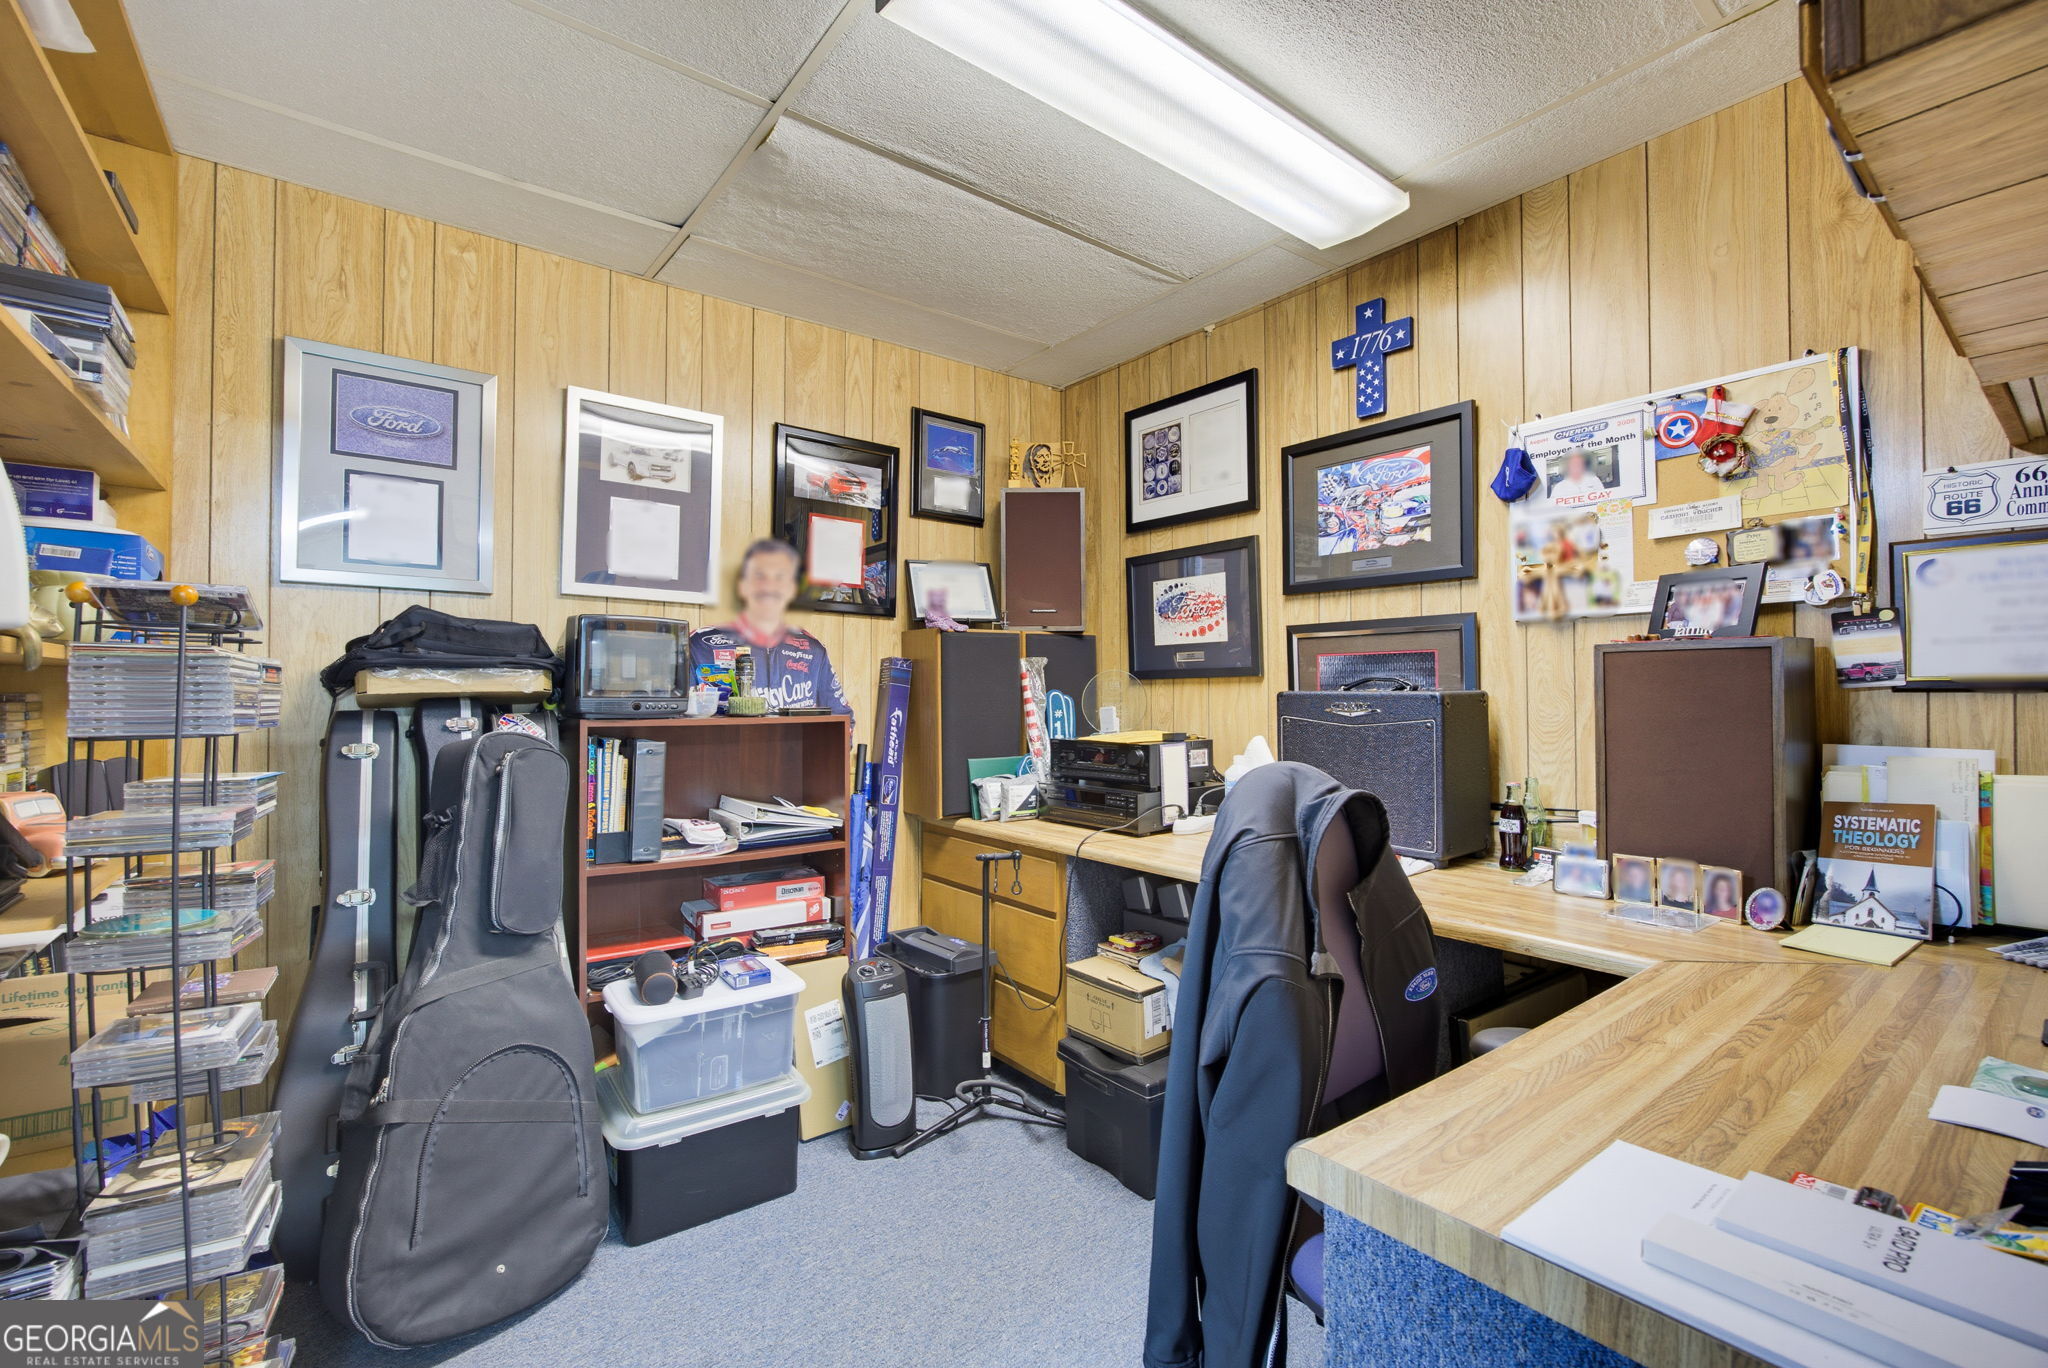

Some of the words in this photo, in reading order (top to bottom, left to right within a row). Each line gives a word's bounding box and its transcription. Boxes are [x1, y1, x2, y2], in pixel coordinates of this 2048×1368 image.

[1350, 326, 1393, 360] 1776
[368, 408, 423, 433] Ford
[1554, 422, 1608, 440] CHEROKEE
[1588, 437, 1602, 448] the
[1606, 433, 1636, 444] Month
[1374, 462, 1410, 482] Ford
[1944, 480, 1984, 489] HISTORIC
[1556, 495, 1584, 505] PETE
[1588, 491, 1611, 501] GAY
[1944, 491, 1984, 500] ROUTE
[1946, 499, 1981, 516] 66
[782, 650, 813, 660] GOODYEAR
[781, 675, 813, 702] Care
[887, 707, 902, 767] Fathead
[1833, 814, 1921, 833] SYSTEMATIC
[1833, 829, 1920, 849] THEOLOGY
[723, 887, 746, 895] SONY
[2, 990, 59, 1004] Lifetime
[1882, 1249, 1911, 1272] PRO
